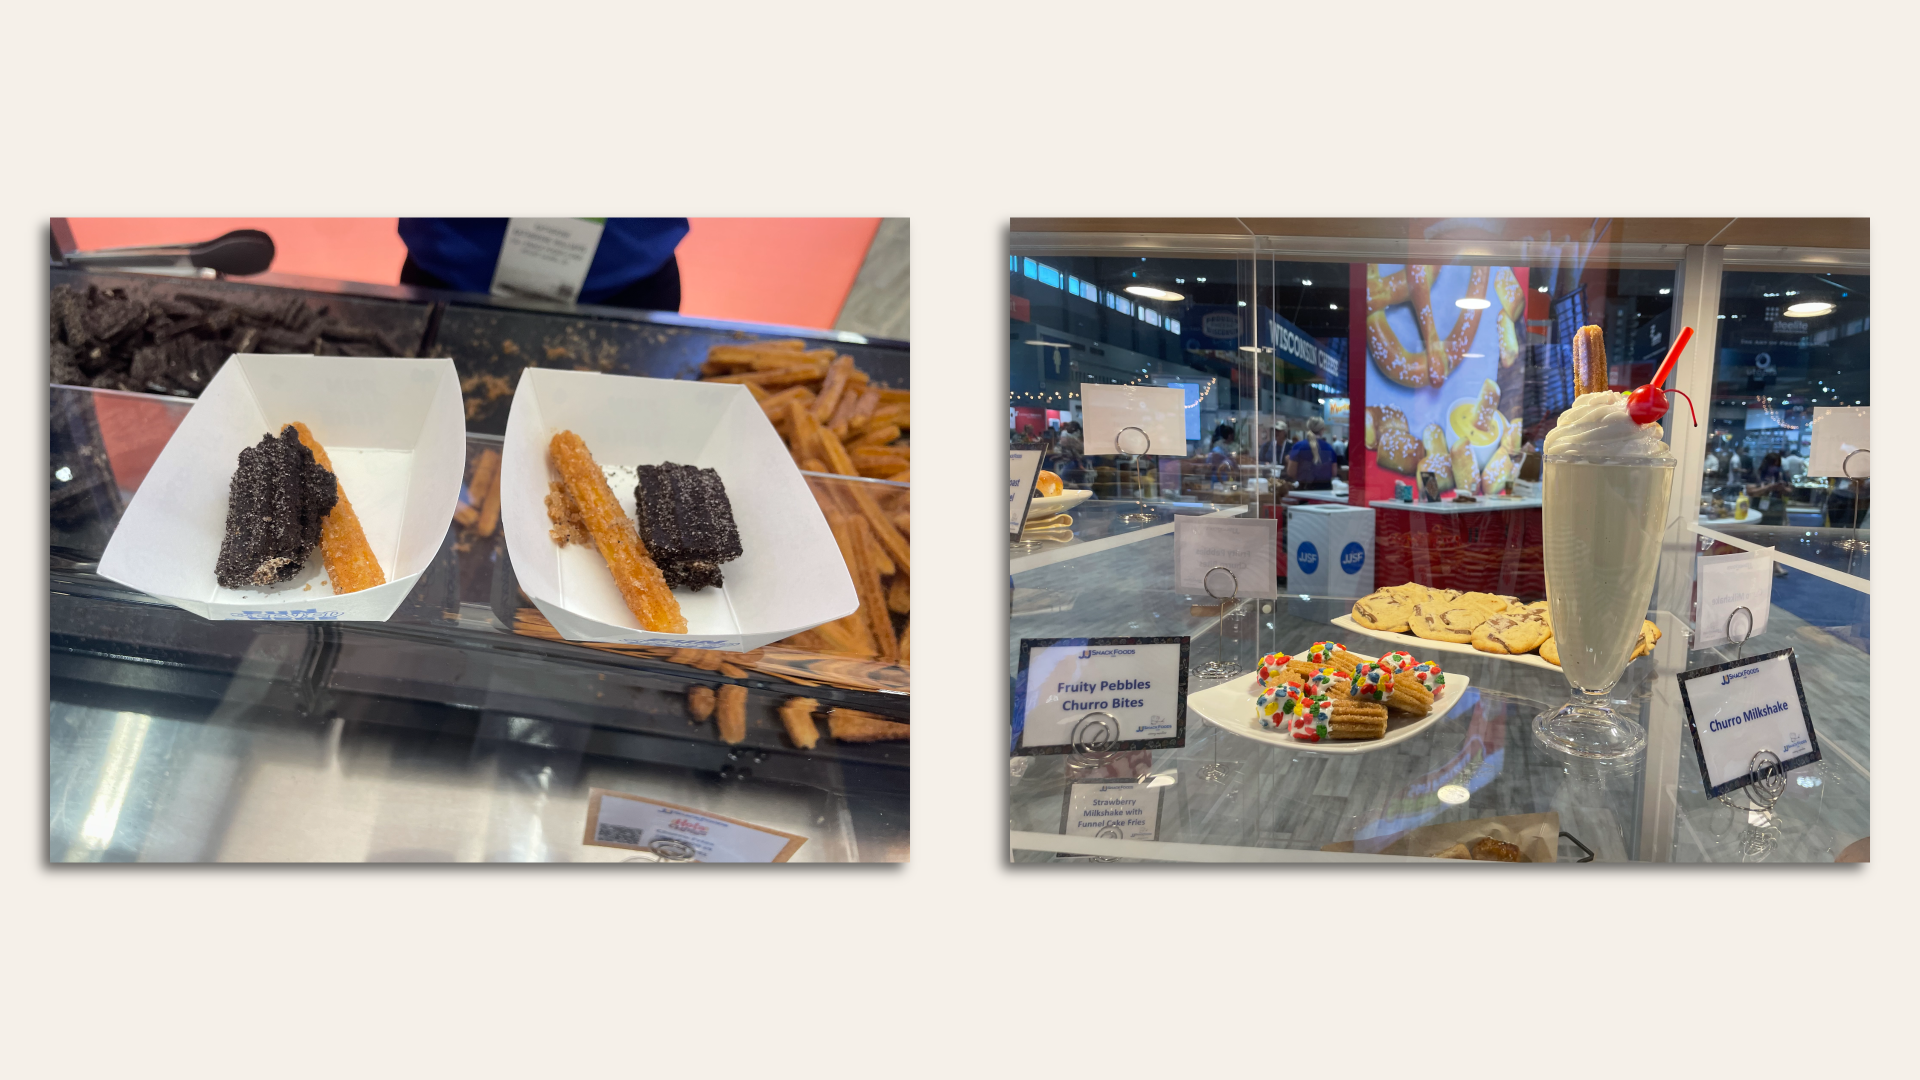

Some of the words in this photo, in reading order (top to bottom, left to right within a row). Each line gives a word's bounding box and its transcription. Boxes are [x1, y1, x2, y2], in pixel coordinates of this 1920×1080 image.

[1269, 319, 1318, 366] WISCONSIN
[1318, 349, 1339, 378] CHEESE
[1298, 552, 1318, 563] JJSF
[1342, 552, 1364, 565] JJSF
[1113, 648, 1136, 656] FOODS
[1743, 667, 1760, 677] FOODS
[1057, 681, 1097, 694] Fruity
[1099, 678, 1151, 691] Pebbles
[1062, 699, 1108, 711] Churro
[1112, 697, 1144, 709] Bites
[1709, 714, 1742, 732] Churro
[1742, 700, 1789, 723] Milkshake
[1092, 798, 1137, 806] Strawberry
[1083, 808, 1124, 817] Milkshake
[1125, 808, 1143, 816] with
[1077, 820, 1105, 828] Funnel
[1127, 818, 1146, 826] Fries
